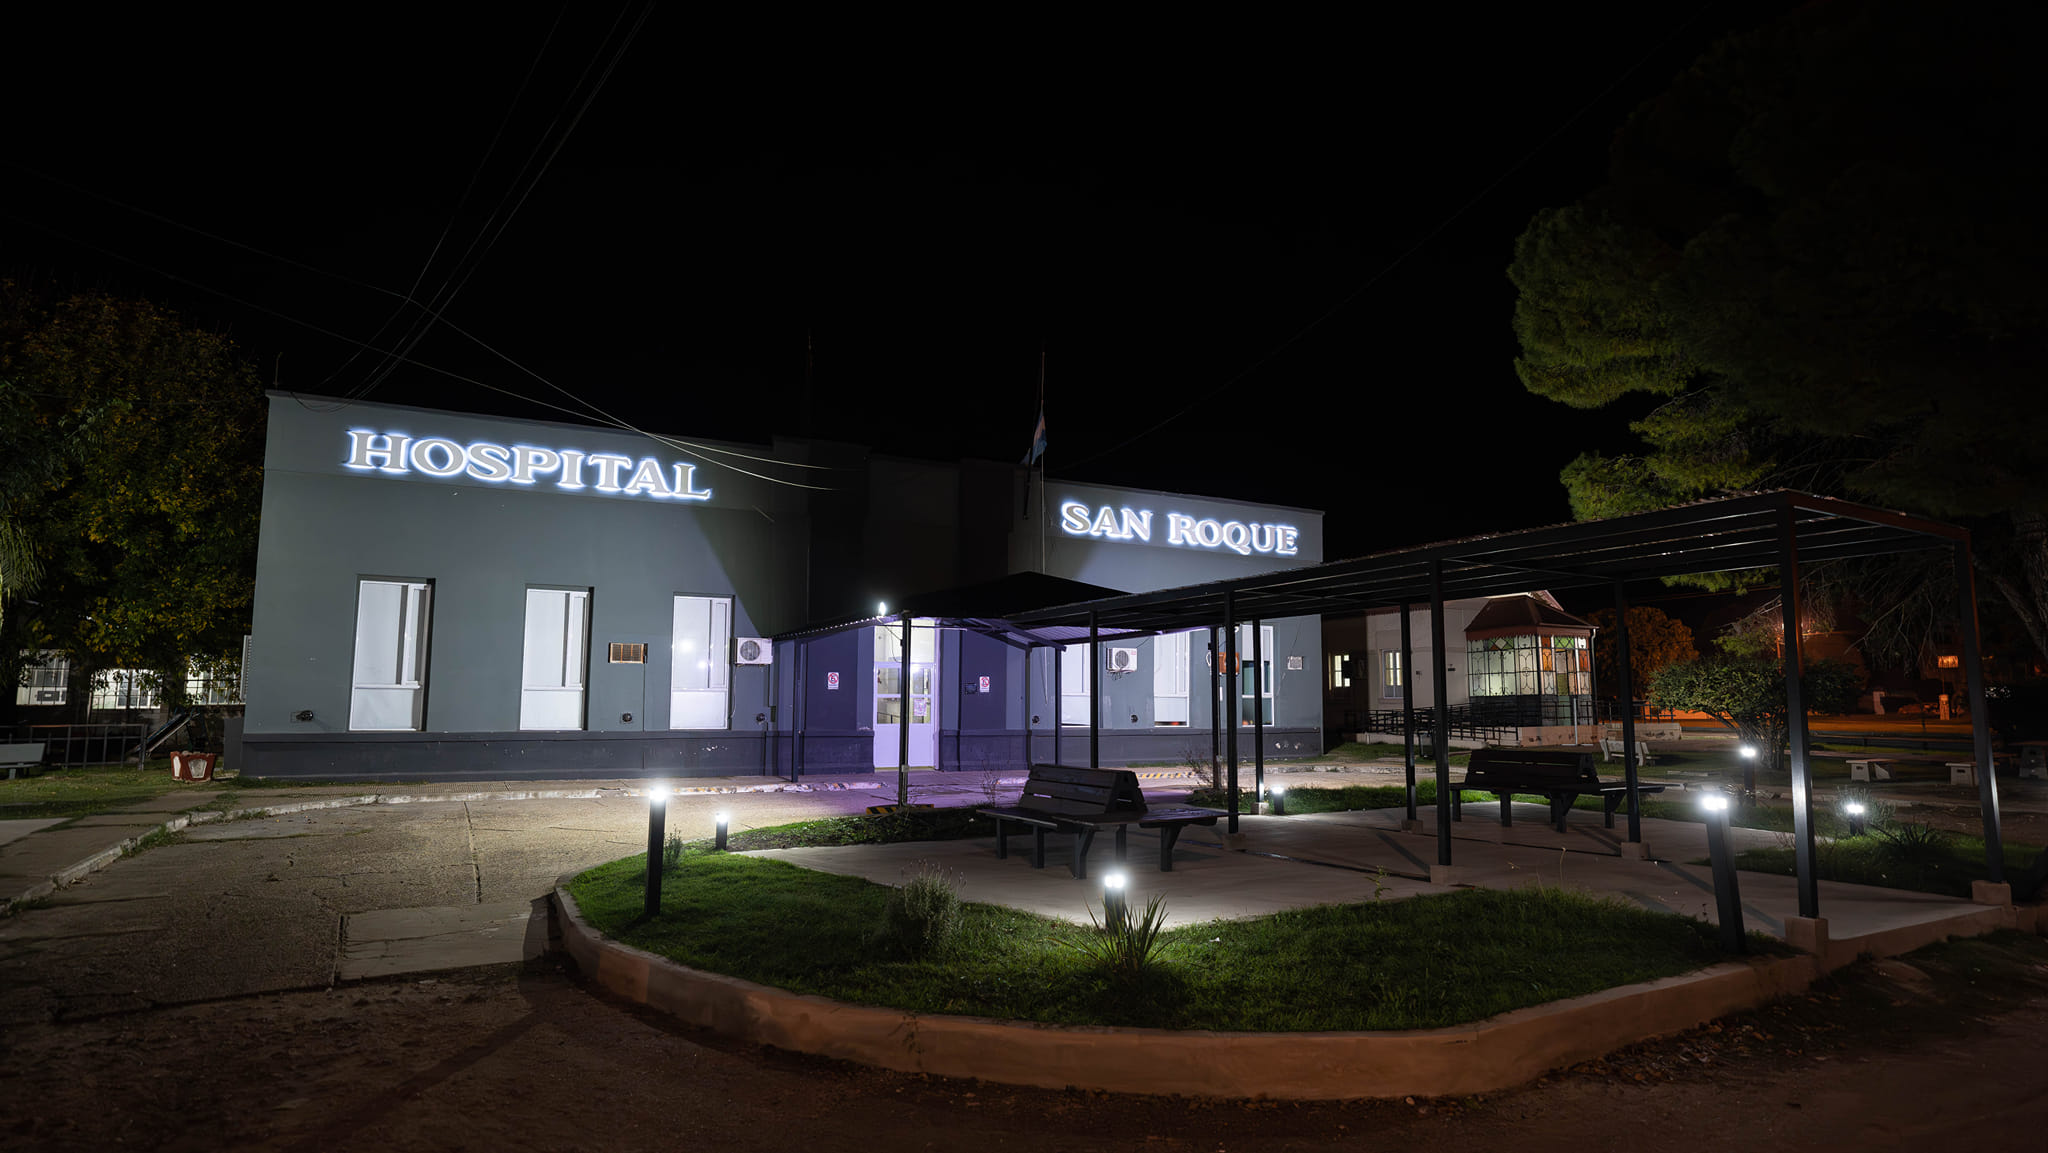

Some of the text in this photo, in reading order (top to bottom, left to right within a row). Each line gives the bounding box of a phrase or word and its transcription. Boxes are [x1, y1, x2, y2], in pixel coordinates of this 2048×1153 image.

[346, 430, 711, 500] HOSPITAL
[1062, 502, 1298, 555] SAN ROQUE
